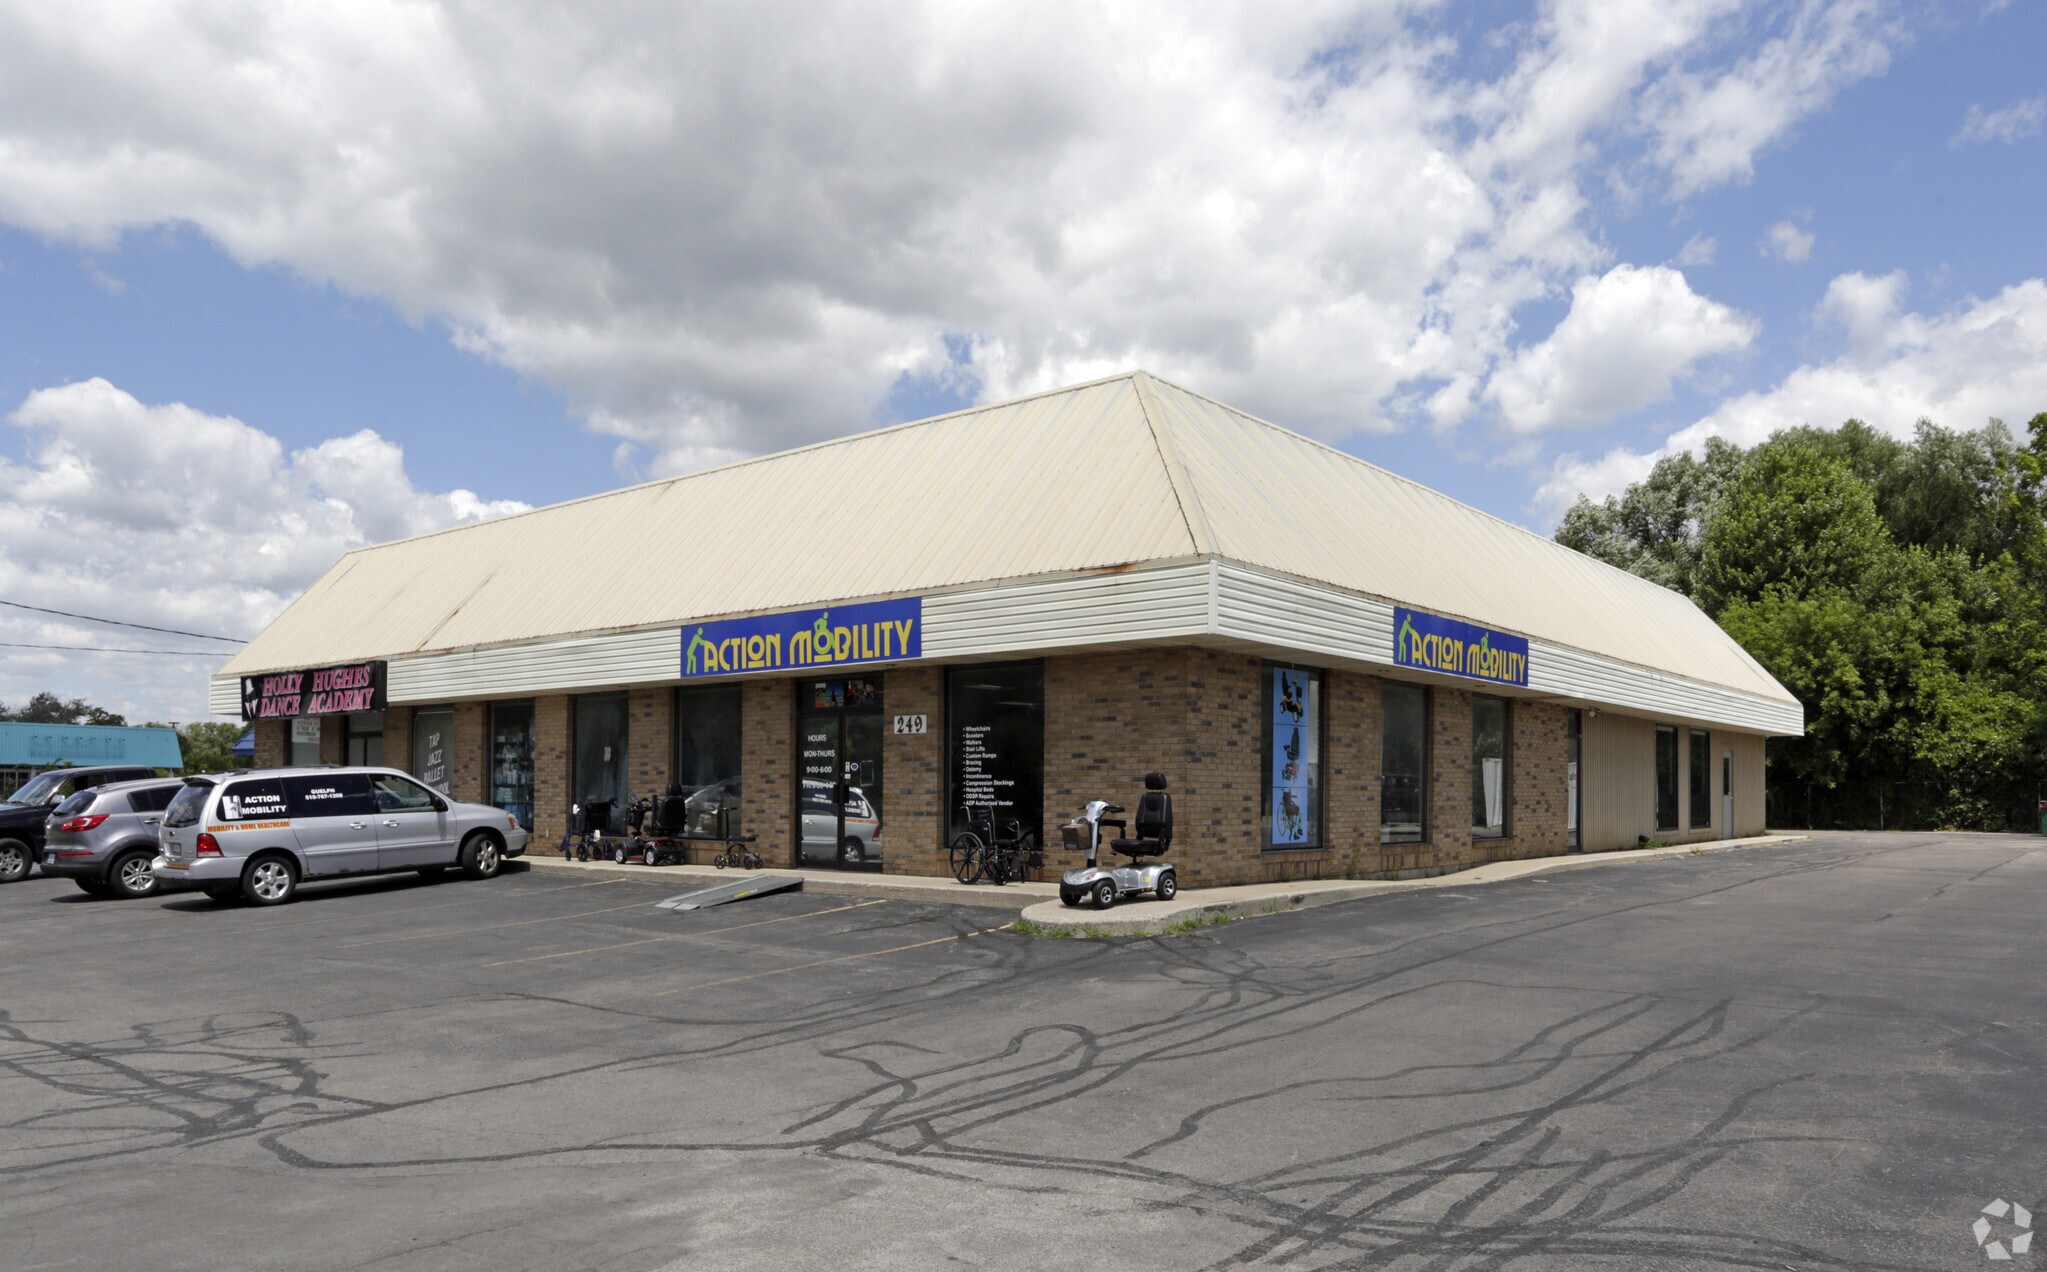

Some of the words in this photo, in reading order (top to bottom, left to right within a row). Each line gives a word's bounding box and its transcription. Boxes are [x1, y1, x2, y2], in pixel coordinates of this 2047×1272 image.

[703, 632, 782, 673] ACTION
[789, 618, 914, 666] MOBILITY
[1411, 630, 1464, 673] ACTION
[1466, 642, 1526, 683] MOBILITY
[262, 673, 304, 697] HOLLY
[311, 665, 371, 692] HUGHES
[259, 695, 301, 718] DANCE
[307, 687, 375, 714] ACADEMY
[896, 716, 923, 733] 249
[429, 732, 440, 748] TAP
[807, 734, 827, 742] HOURS
[427, 749, 442, 767] JAZZ
[803, 750, 836, 758] MON-THURS
[423, 765, 445, 784] BALLET
[244, 795, 280, 804] ACTION
[242, 805, 287, 815] MOBILITY
[207, 824, 235, 832] MOBILITY
[240, 823, 256, 831] HOME
[257, 821, 290, 829] HEALTHCARE
